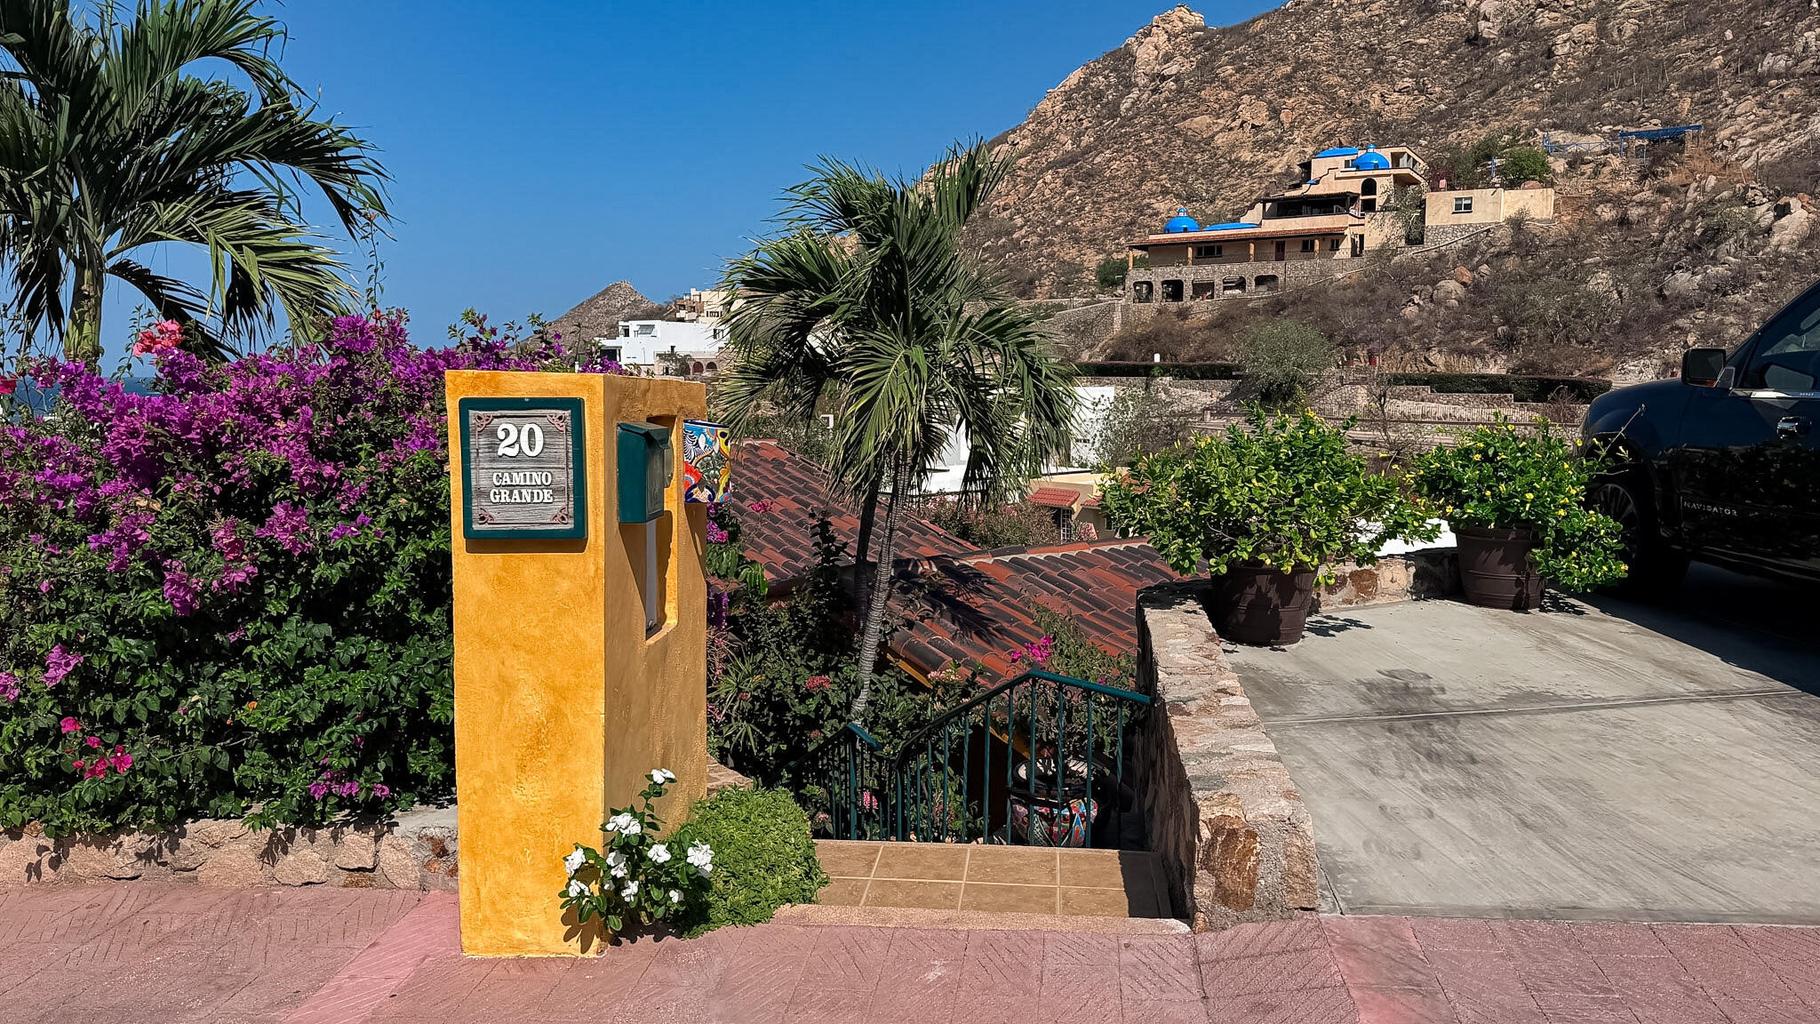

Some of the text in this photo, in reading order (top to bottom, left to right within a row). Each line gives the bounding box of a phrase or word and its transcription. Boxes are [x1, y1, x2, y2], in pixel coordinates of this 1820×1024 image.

[497, 423, 544, 457] 20
[492, 472, 552, 486] CAMINO
[489, 489, 553, 503] GRANDE
[1683, 501, 1738, 517] NAVIGATOR
